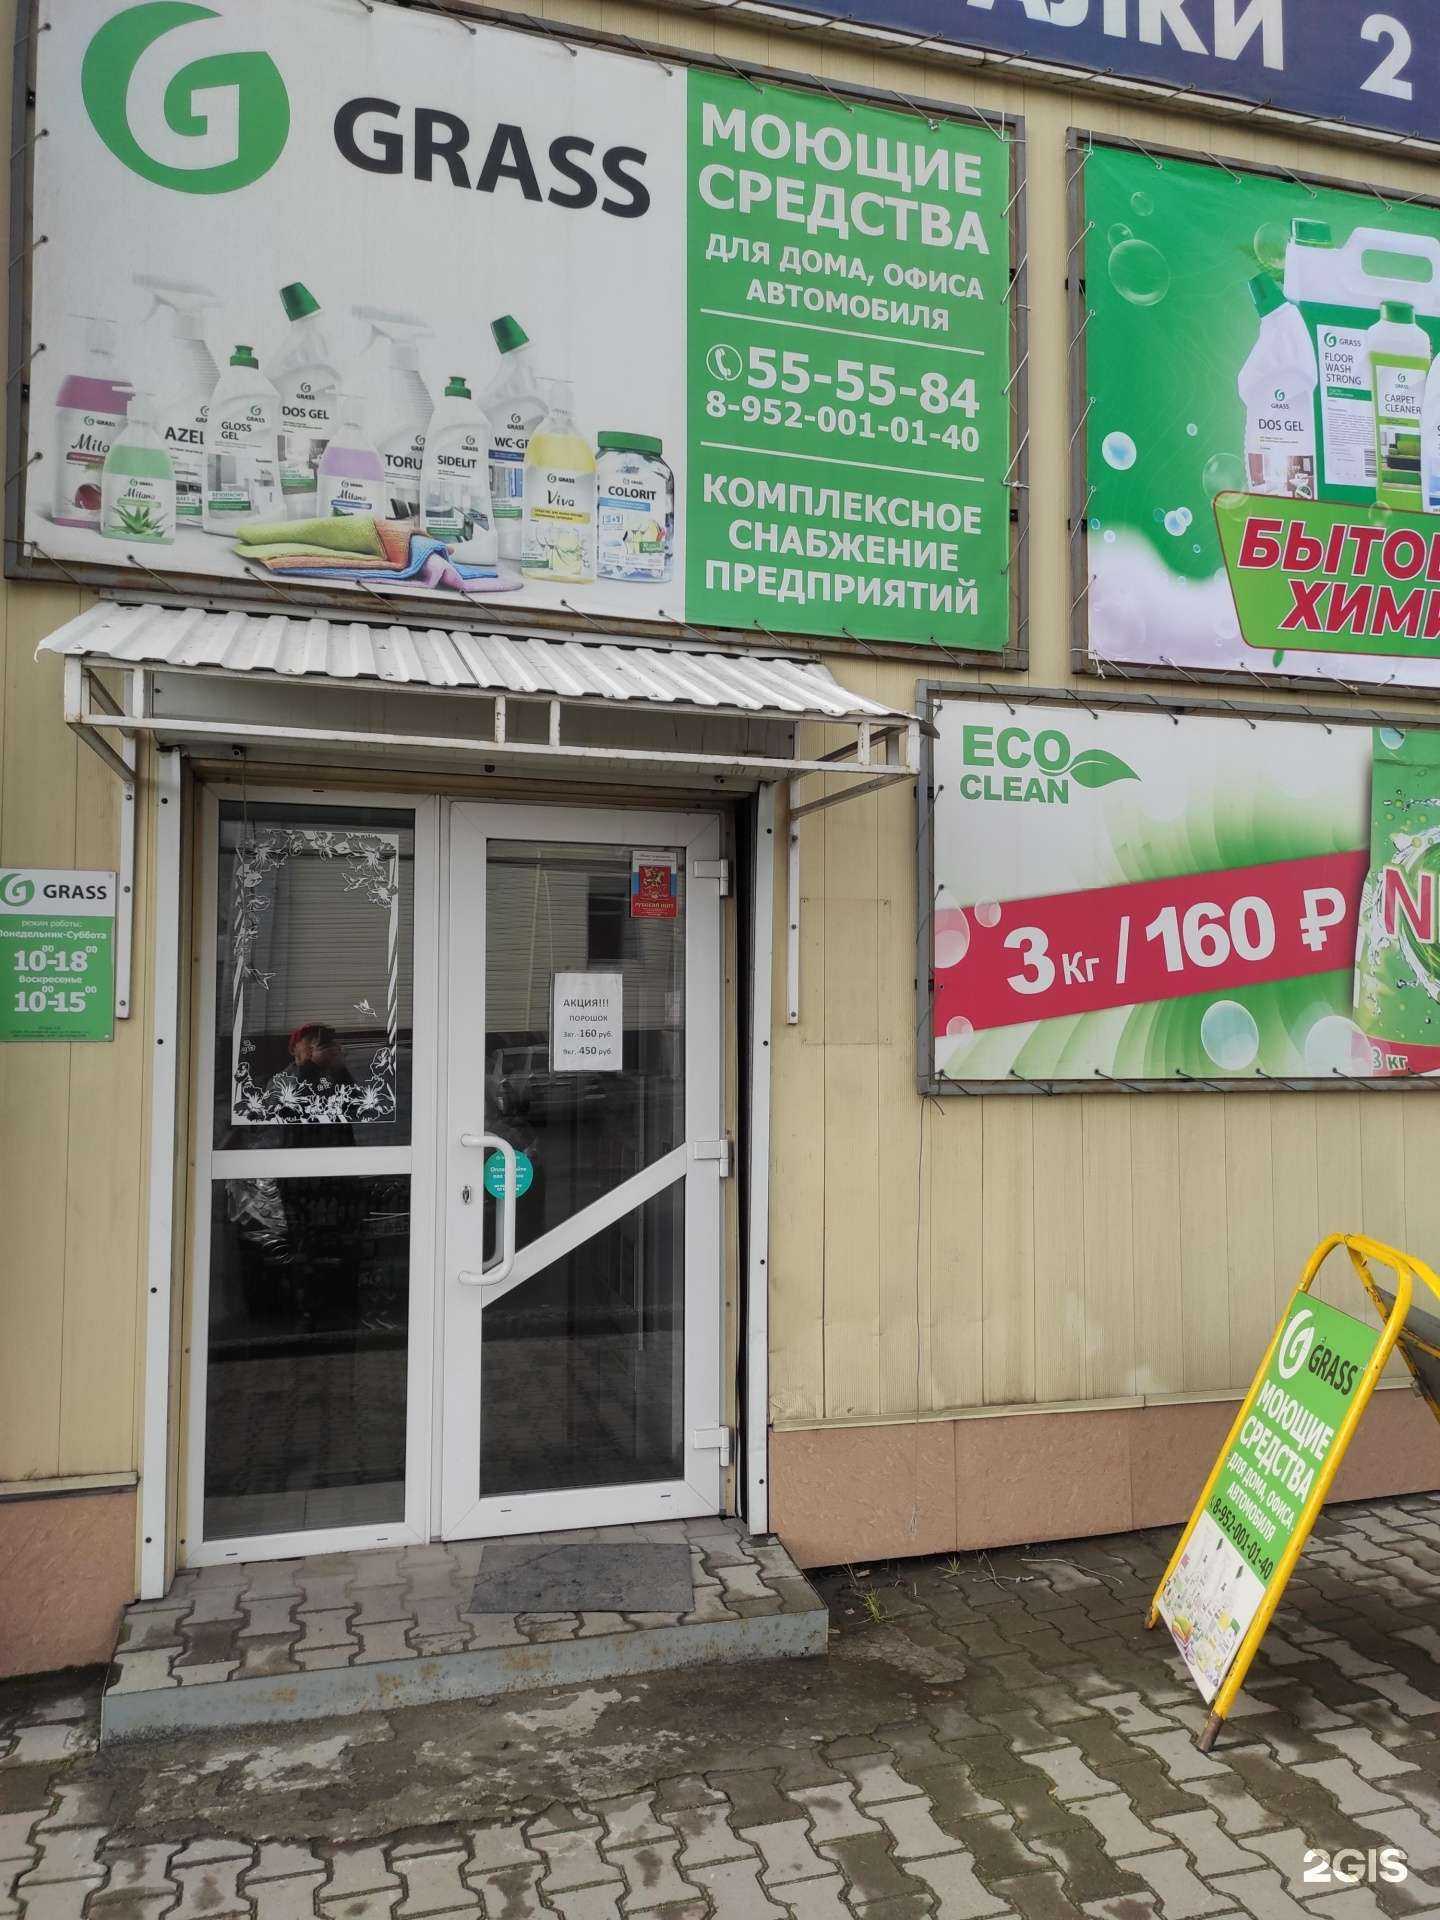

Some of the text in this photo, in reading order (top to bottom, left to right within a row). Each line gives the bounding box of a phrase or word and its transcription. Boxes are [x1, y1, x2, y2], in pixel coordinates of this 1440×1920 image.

[1360, 13, 1413, 101] 2
[333, 97, 652, 219] GRASS
[702, 102, 982, 197] МОЮЩИЕ
[699, 164, 990, 255] СРЕДСТВА
[705, 233, 985, 300] ДЛЯ ДОМА, ОФИСА
[746, 278, 949, 331] АВТОМОБИЛЯ
[747, 346, 980, 418] 55-55-84
[1325, 353, 1354, 363] FLOOR
[1325, 363, 1352, 374] WASH
[1326, 373, 1362, 386] STRONG
[282, 406, 330, 420] DOS GEL
[705, 390, 980, 453] 8-952-001-01-40
[1384, 394, 1415, 405] CARPET
[1385, 403, 1422, 415] CLEANER
[221, 421, 252, 432] GLOSS
[221, 431, 239, 441] GEL
[1258, 419, 1304, 432] DOS GEL
[437, 455, 477, 469] SIDELIT
[547, 490, 575, 507] Viva
[608, 486, 656, 501] COLORIT
[703, 473, 982, 535] КОМПЛЕКСНОЕ
[728, 519, 959, 572] СНАБЖЕНИЕ
[705, 559, 979, 616] ПРЕДПРИЯТИЙ
[961, 725, 1071, 771] ECO
[959, 774, 1069, 804] CLEAN
[43, 884, 107, 900] GRASS
[1145, 896, 1276, 972] 160
[19, 975, 82, 985] Воскресенье
[563, 998, 609, 1009] АКЦИЯ!!!
[1308, 1344, 1358, 1396] GRASS
[1256, 1379, 1334, 1461] МОЮЩИЕ
[1240, 1415, 1315, 1504] СРЕДСТВА
[1226, 1481, 1276, 1543] АВТОМОБИЛЯ
[1212, 1498, 1274, 1580] 8-952-001-01-40
